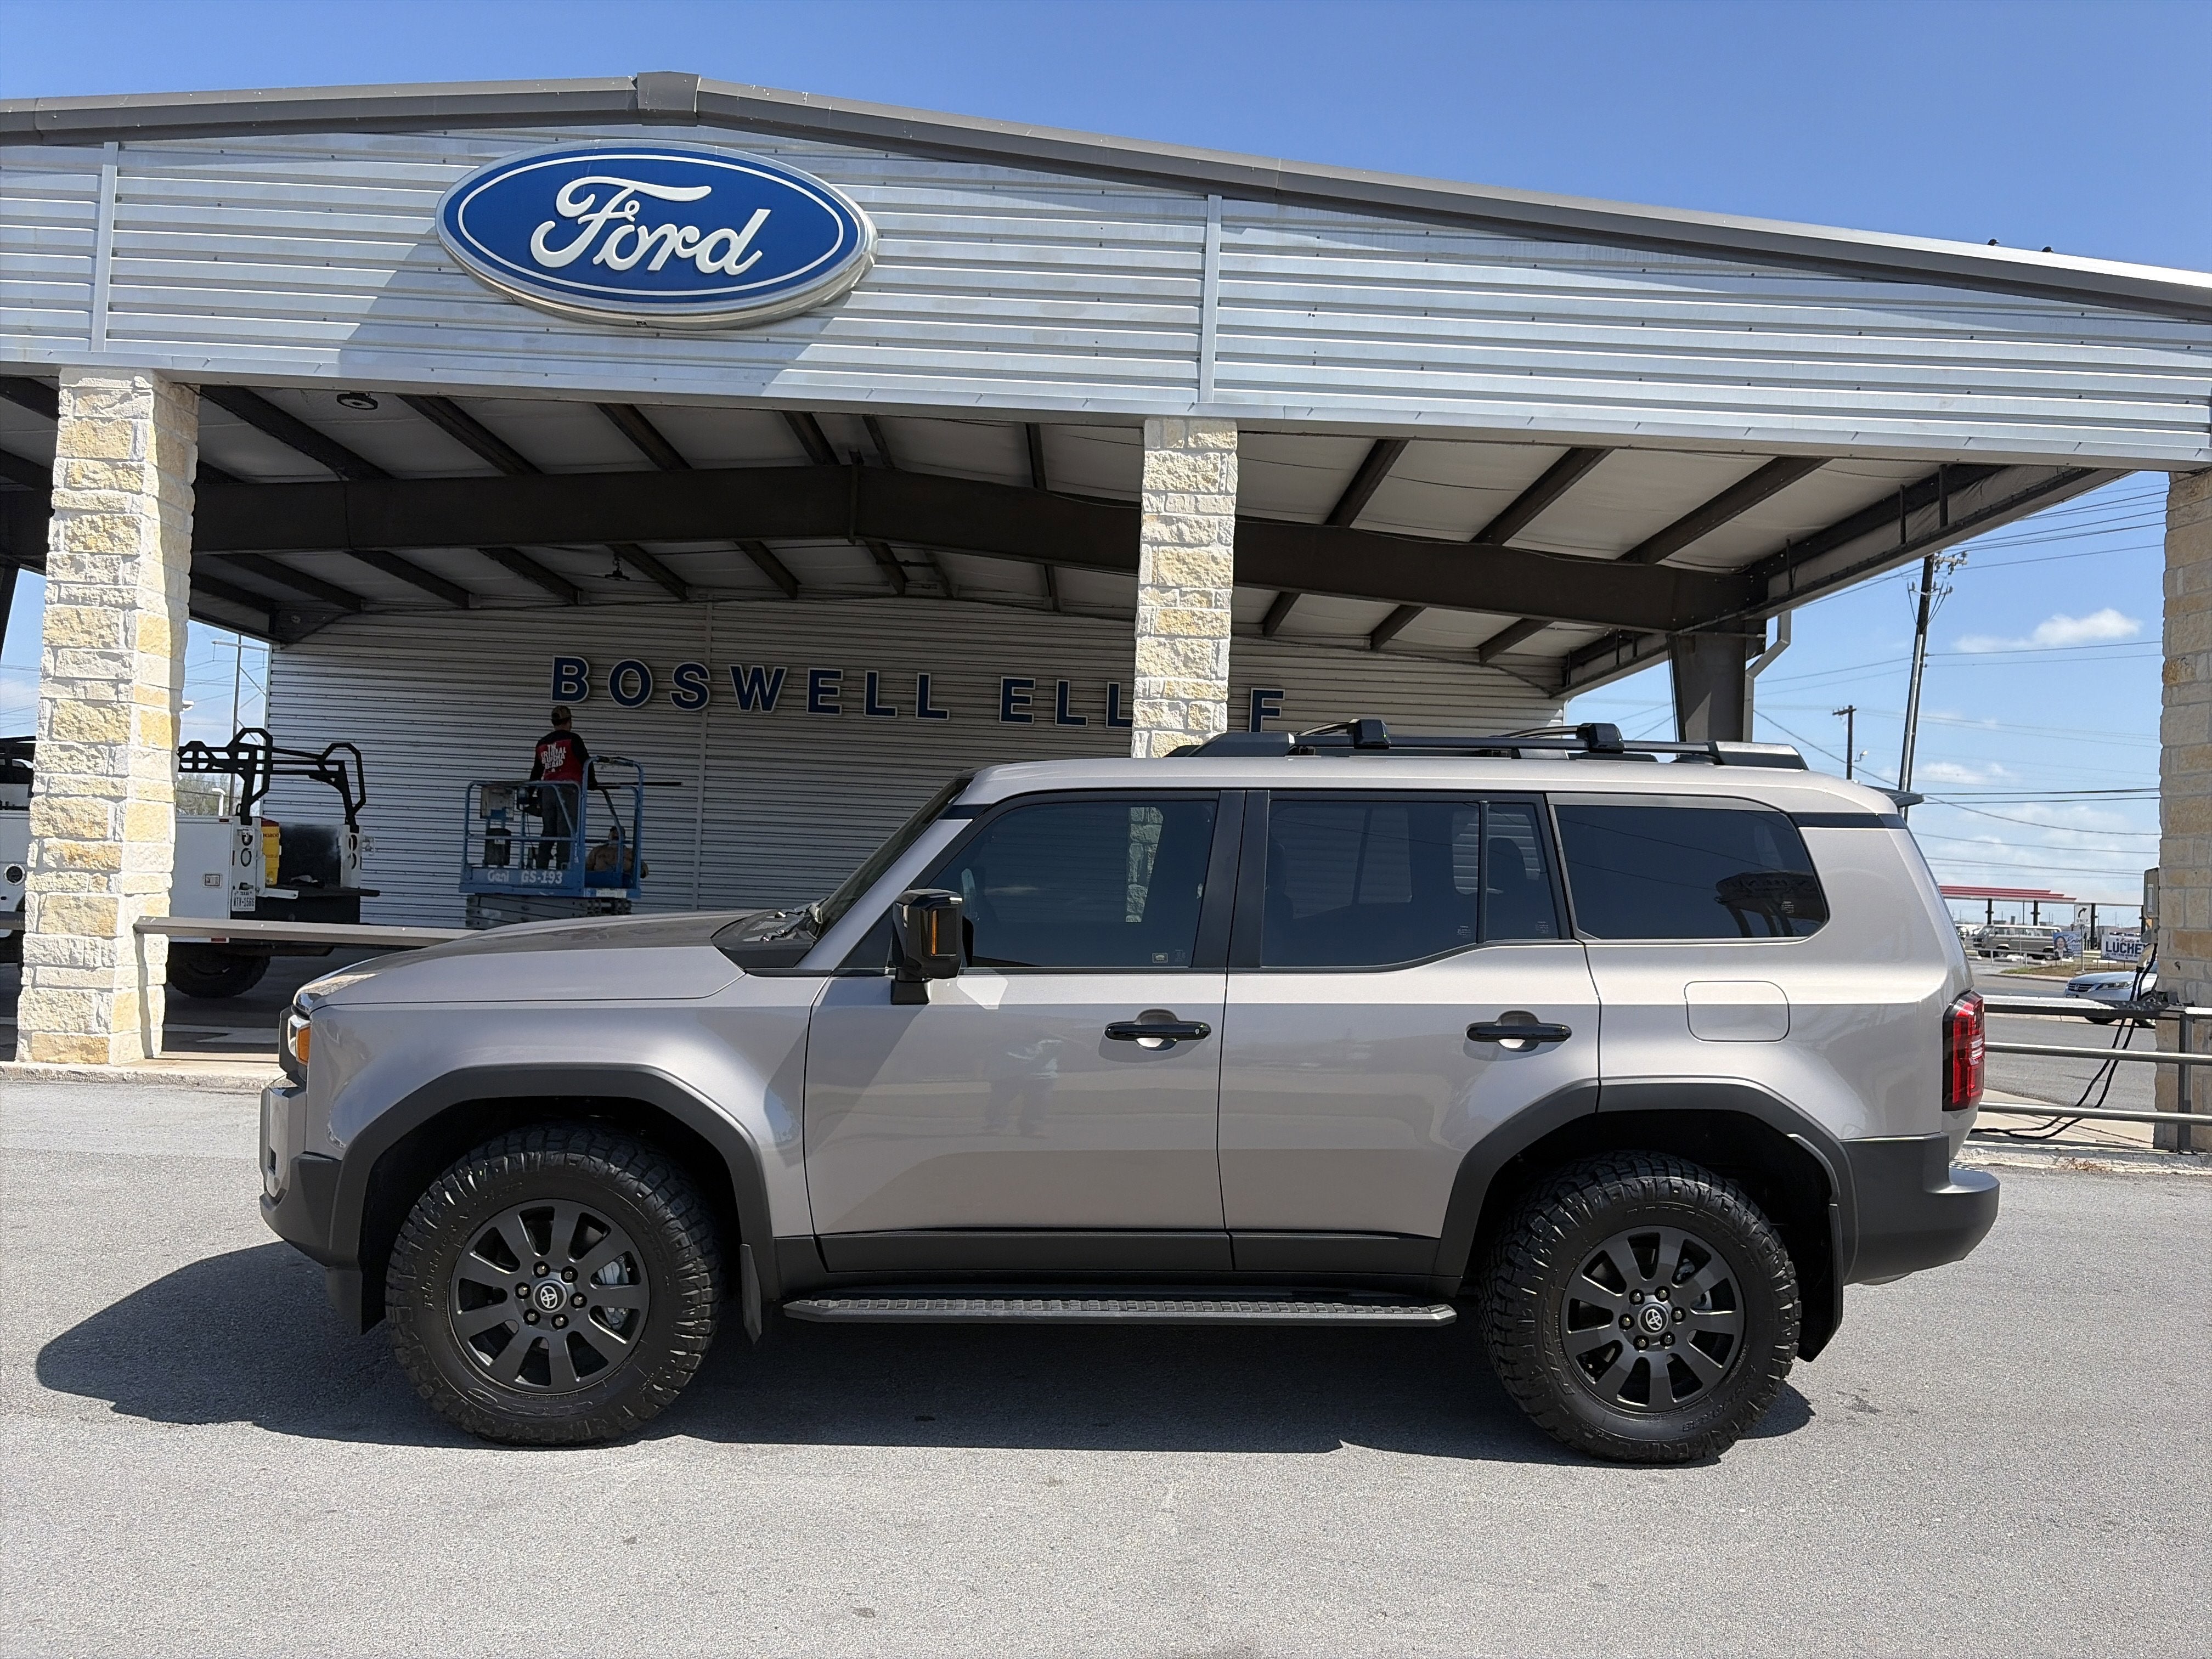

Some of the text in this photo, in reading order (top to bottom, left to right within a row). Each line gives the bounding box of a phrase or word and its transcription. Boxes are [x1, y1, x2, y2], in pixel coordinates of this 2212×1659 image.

[531, 176, 771, 276] Ford
[550, 655, 950, 721] BOSWELL
[2106, 940, 2146, 955] LUCKE
